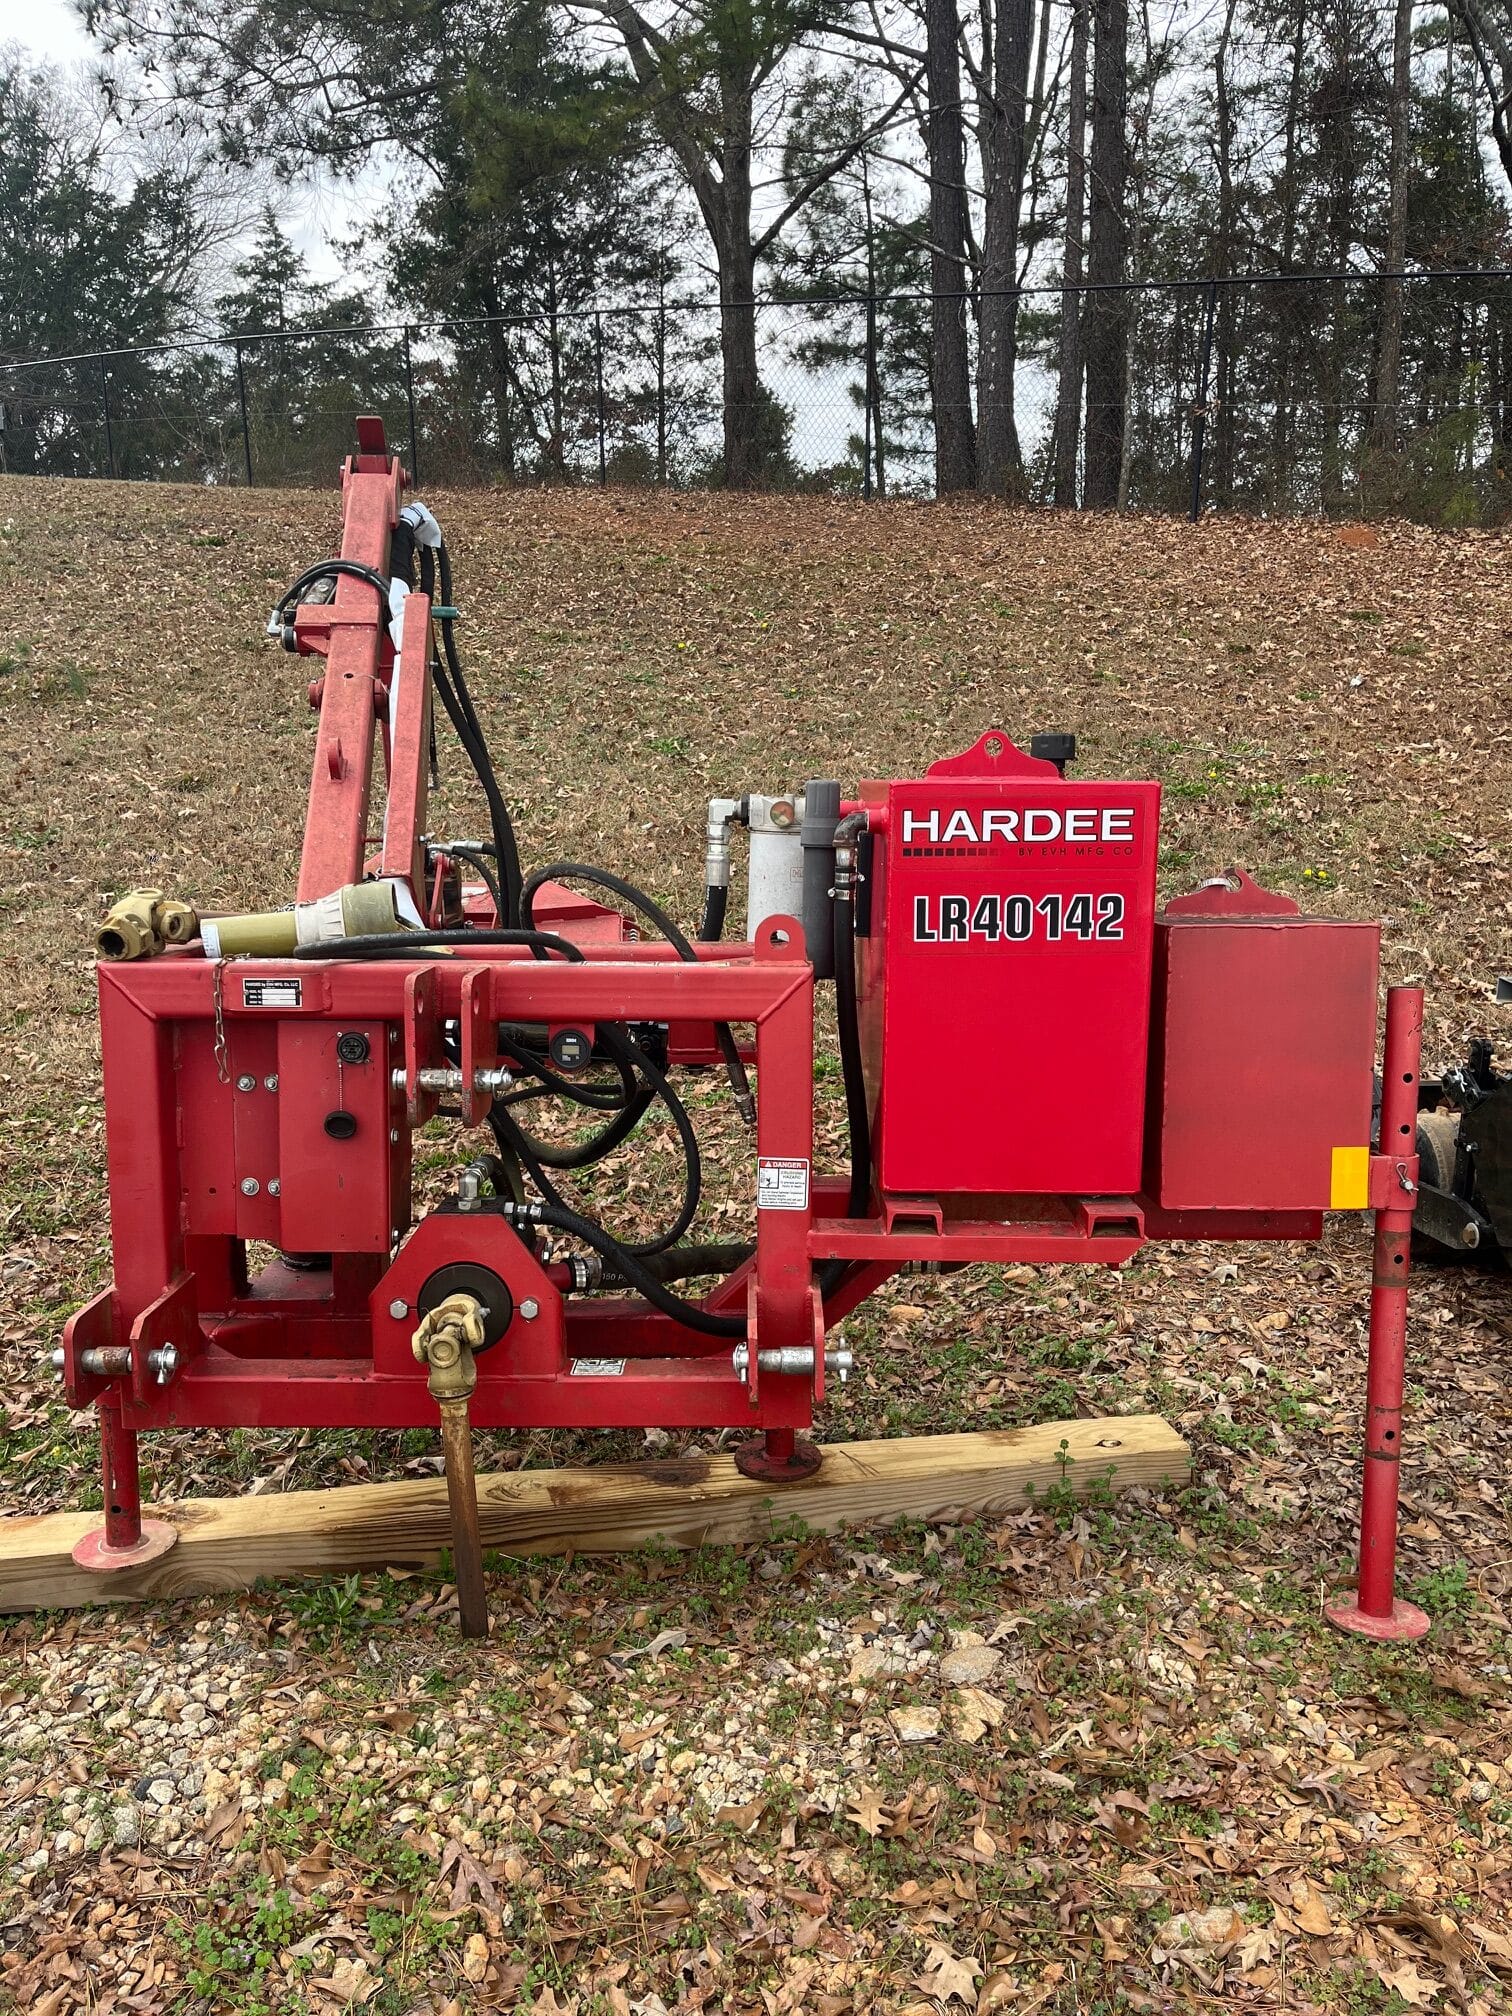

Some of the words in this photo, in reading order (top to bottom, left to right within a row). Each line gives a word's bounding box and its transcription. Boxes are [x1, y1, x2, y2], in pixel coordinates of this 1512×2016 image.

[902, 808, 1135, 843] HARDEE
[1018, 847, 1033, 856] BY
[1041, 847, 1067, 856] EVH
[1075, 847, 1104, 856] MFG
[1113, 846, 1133, 856] CO
[913, 893, 1125, 942] LR40142
